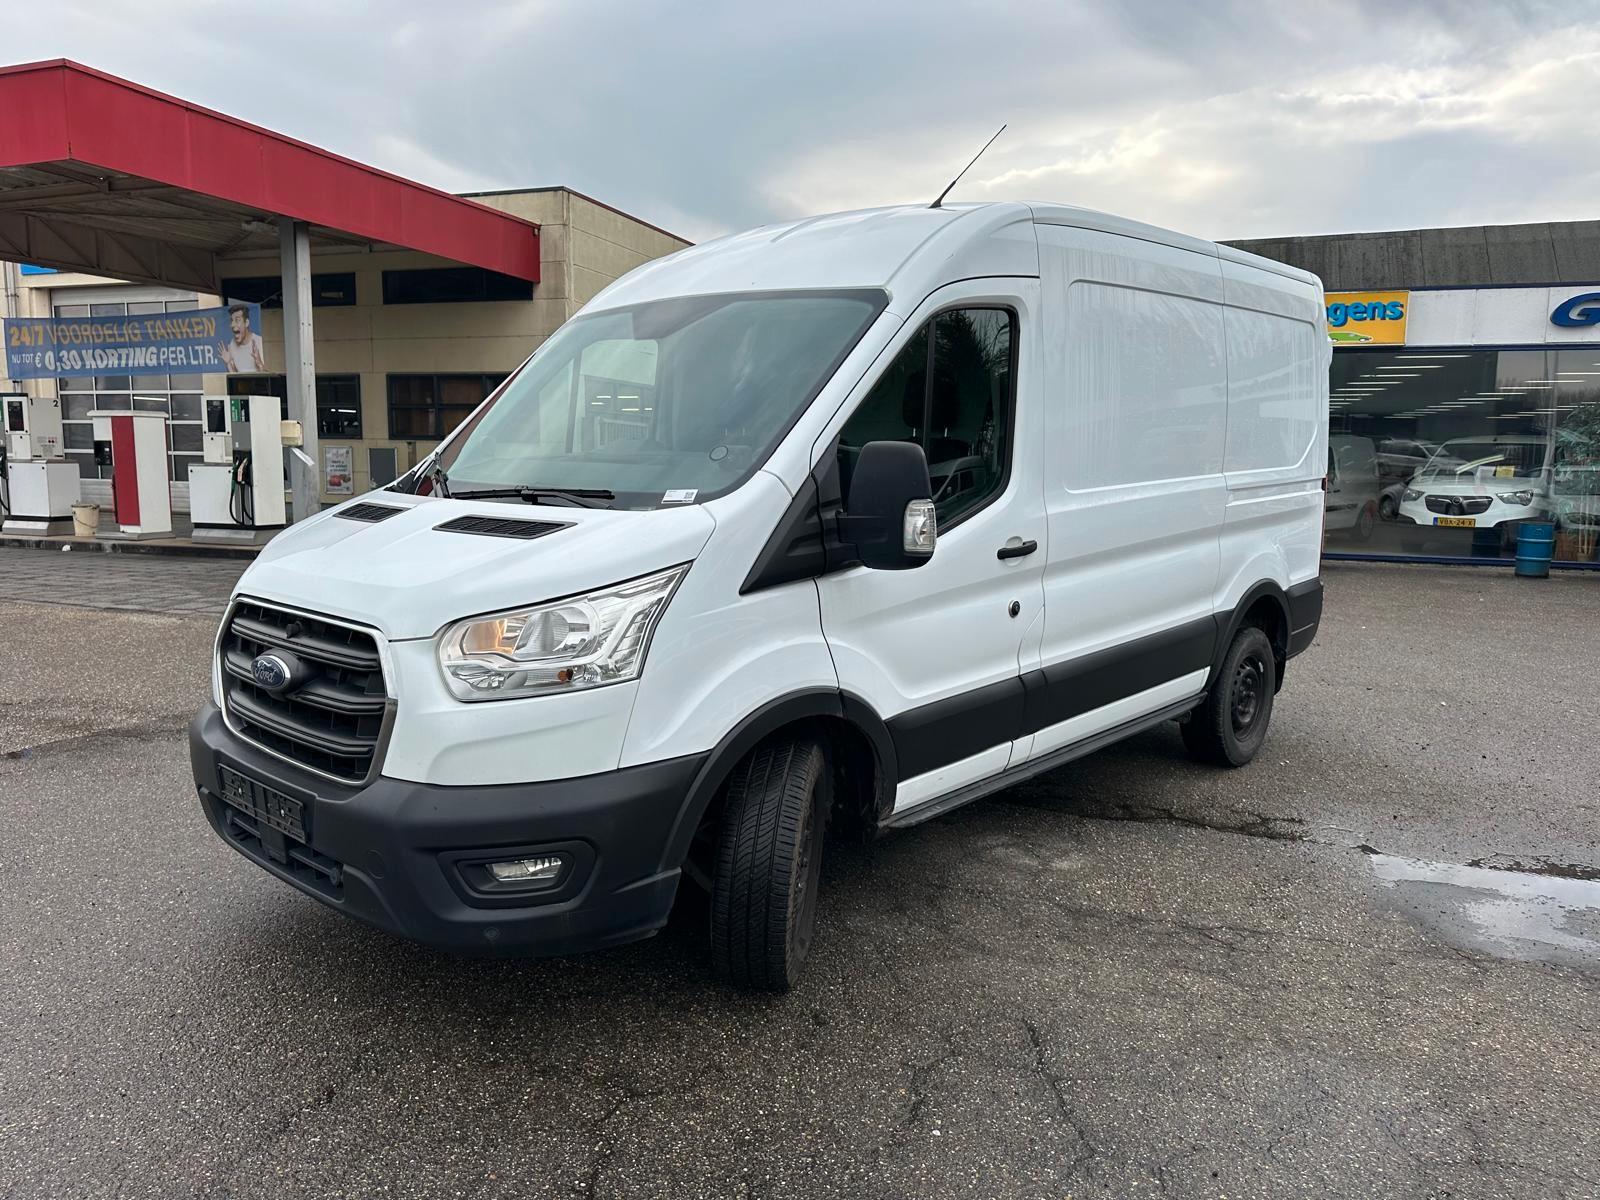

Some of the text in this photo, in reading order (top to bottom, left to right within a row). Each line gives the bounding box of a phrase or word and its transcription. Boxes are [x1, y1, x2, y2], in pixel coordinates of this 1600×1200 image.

[1326, 301, 1404, 327] gens
[10, 317, 216, 346] 24/7 VOORDELIG TANKEN
[12, 345, 218, 371] NU TOT € 0,30 KORTING PER LTR.
[29, 398, 34, 406] 1
[53, 400, 59, 408] 2
[255, 660, 277, 683] Ford
